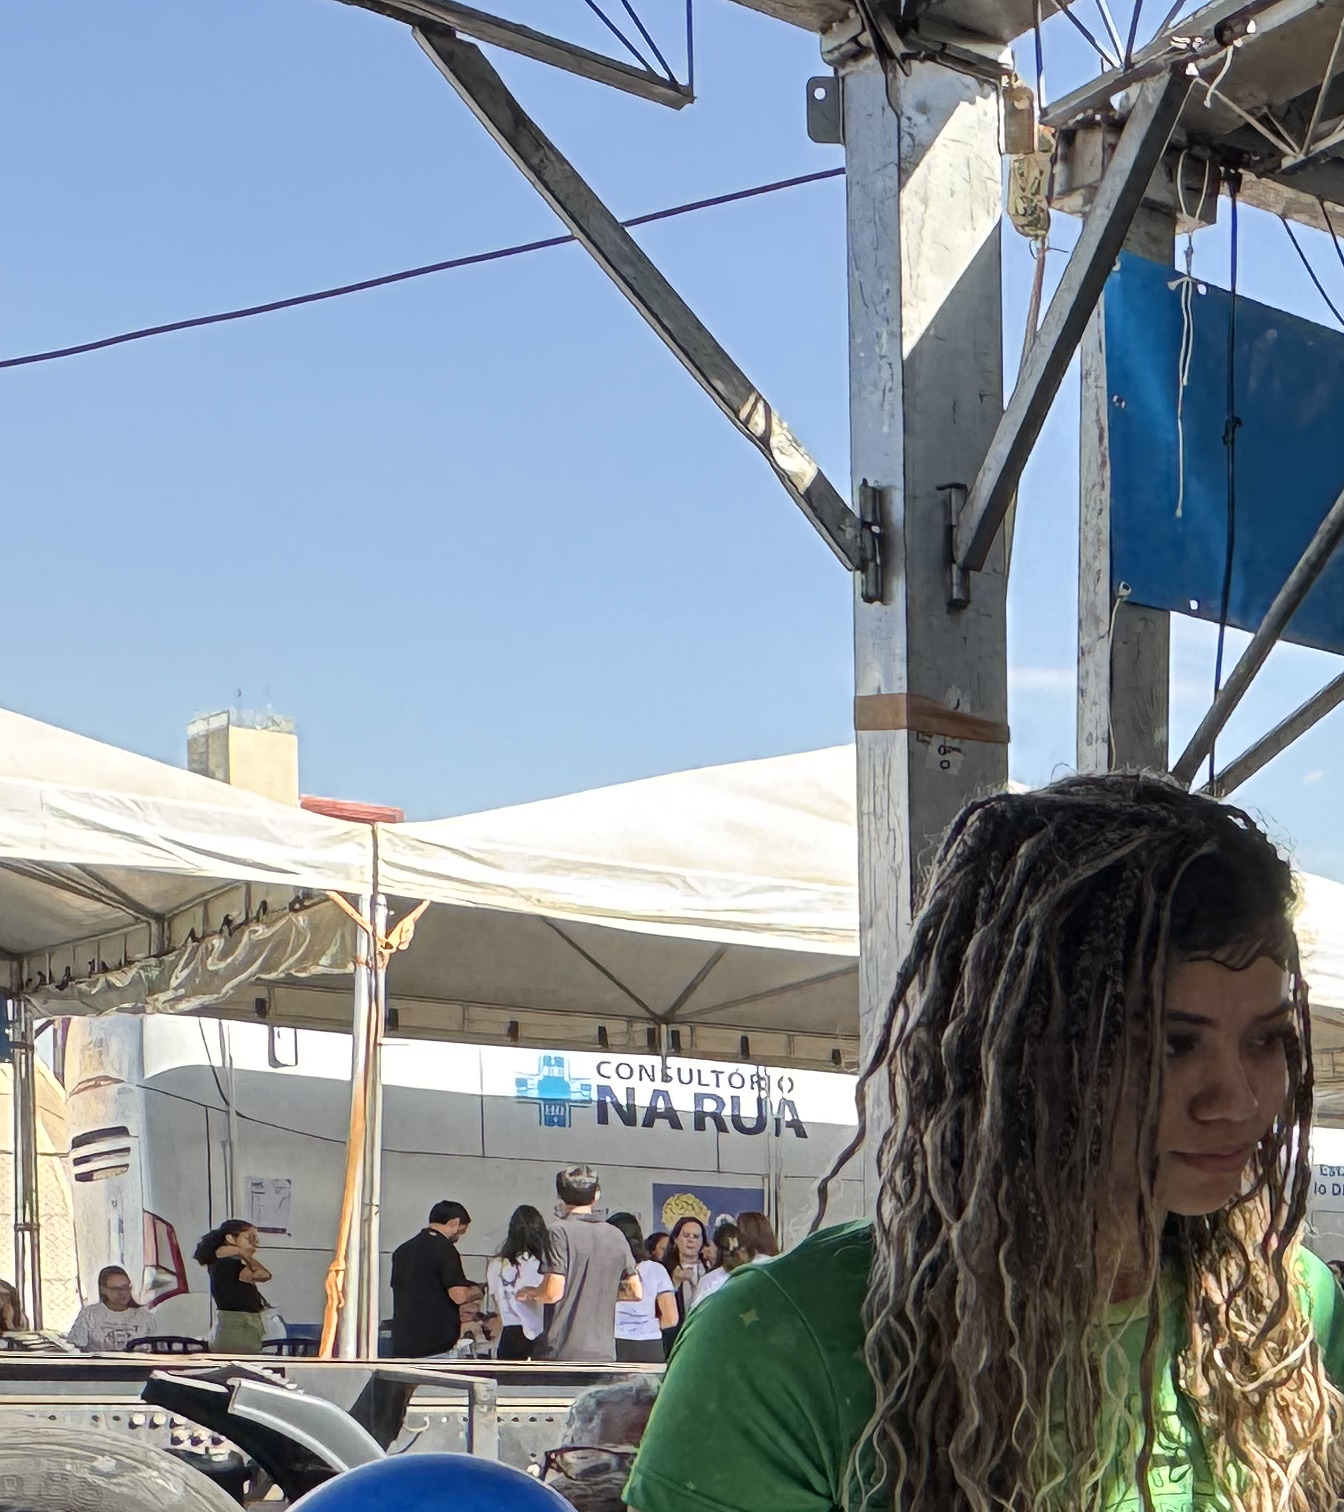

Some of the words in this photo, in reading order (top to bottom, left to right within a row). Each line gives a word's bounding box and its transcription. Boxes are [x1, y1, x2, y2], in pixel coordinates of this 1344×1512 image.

[596, 1061, 795, 1094] CONSULTÓRO
[597, 1084, 684, 1131] NA
[694, 1092, 809, 1139] RUA
